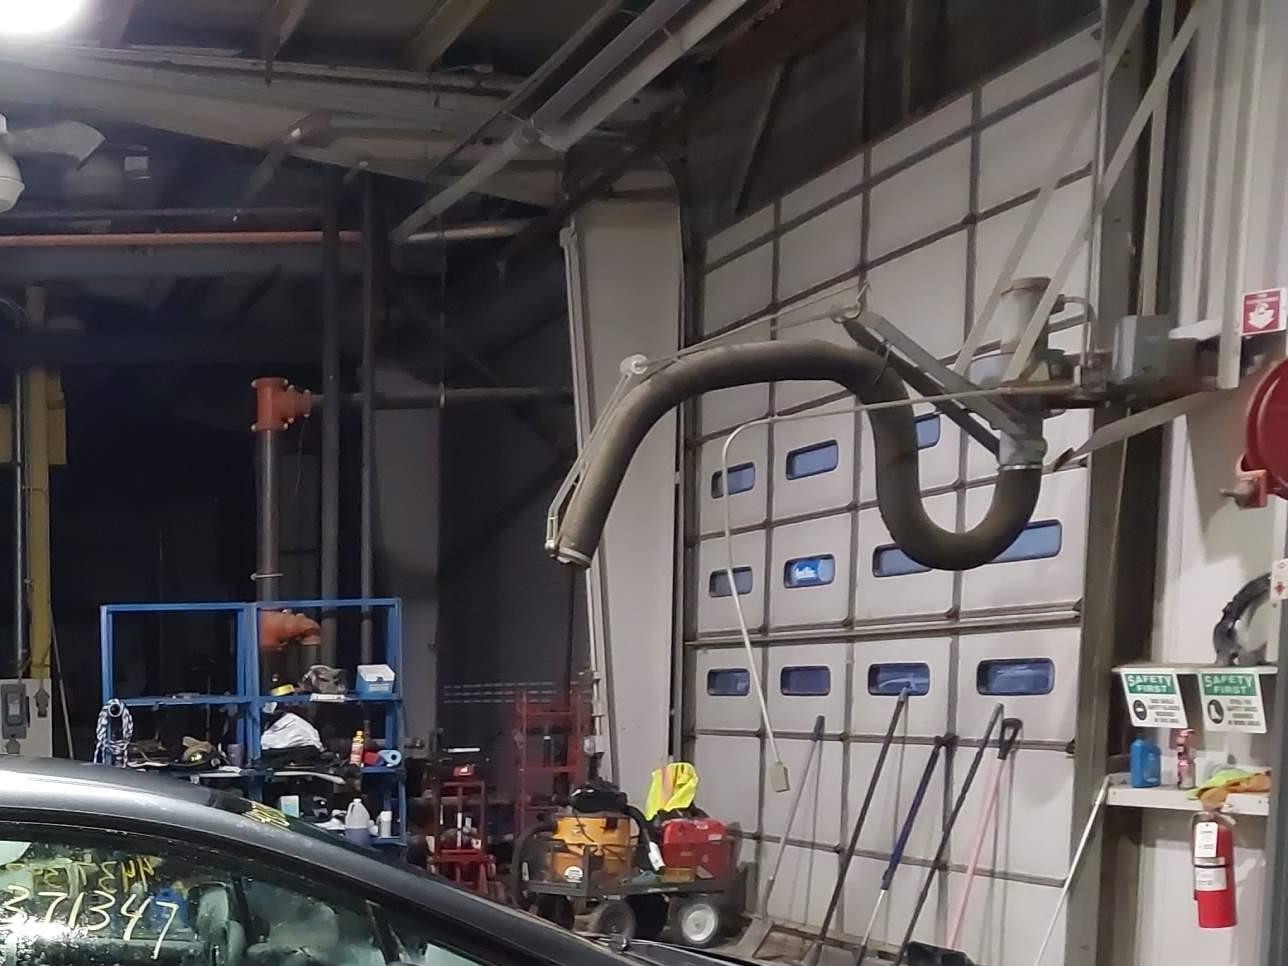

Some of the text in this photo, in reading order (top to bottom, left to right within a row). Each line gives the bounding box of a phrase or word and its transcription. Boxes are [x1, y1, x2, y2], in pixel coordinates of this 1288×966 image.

[1127, 675, 1172, 687] SAFETY
[1204, 675, 1253, 688] SAFETY
[1137, 685, 1167, 693] FIRST
[1213, 686, 1247, 694] FIRST
